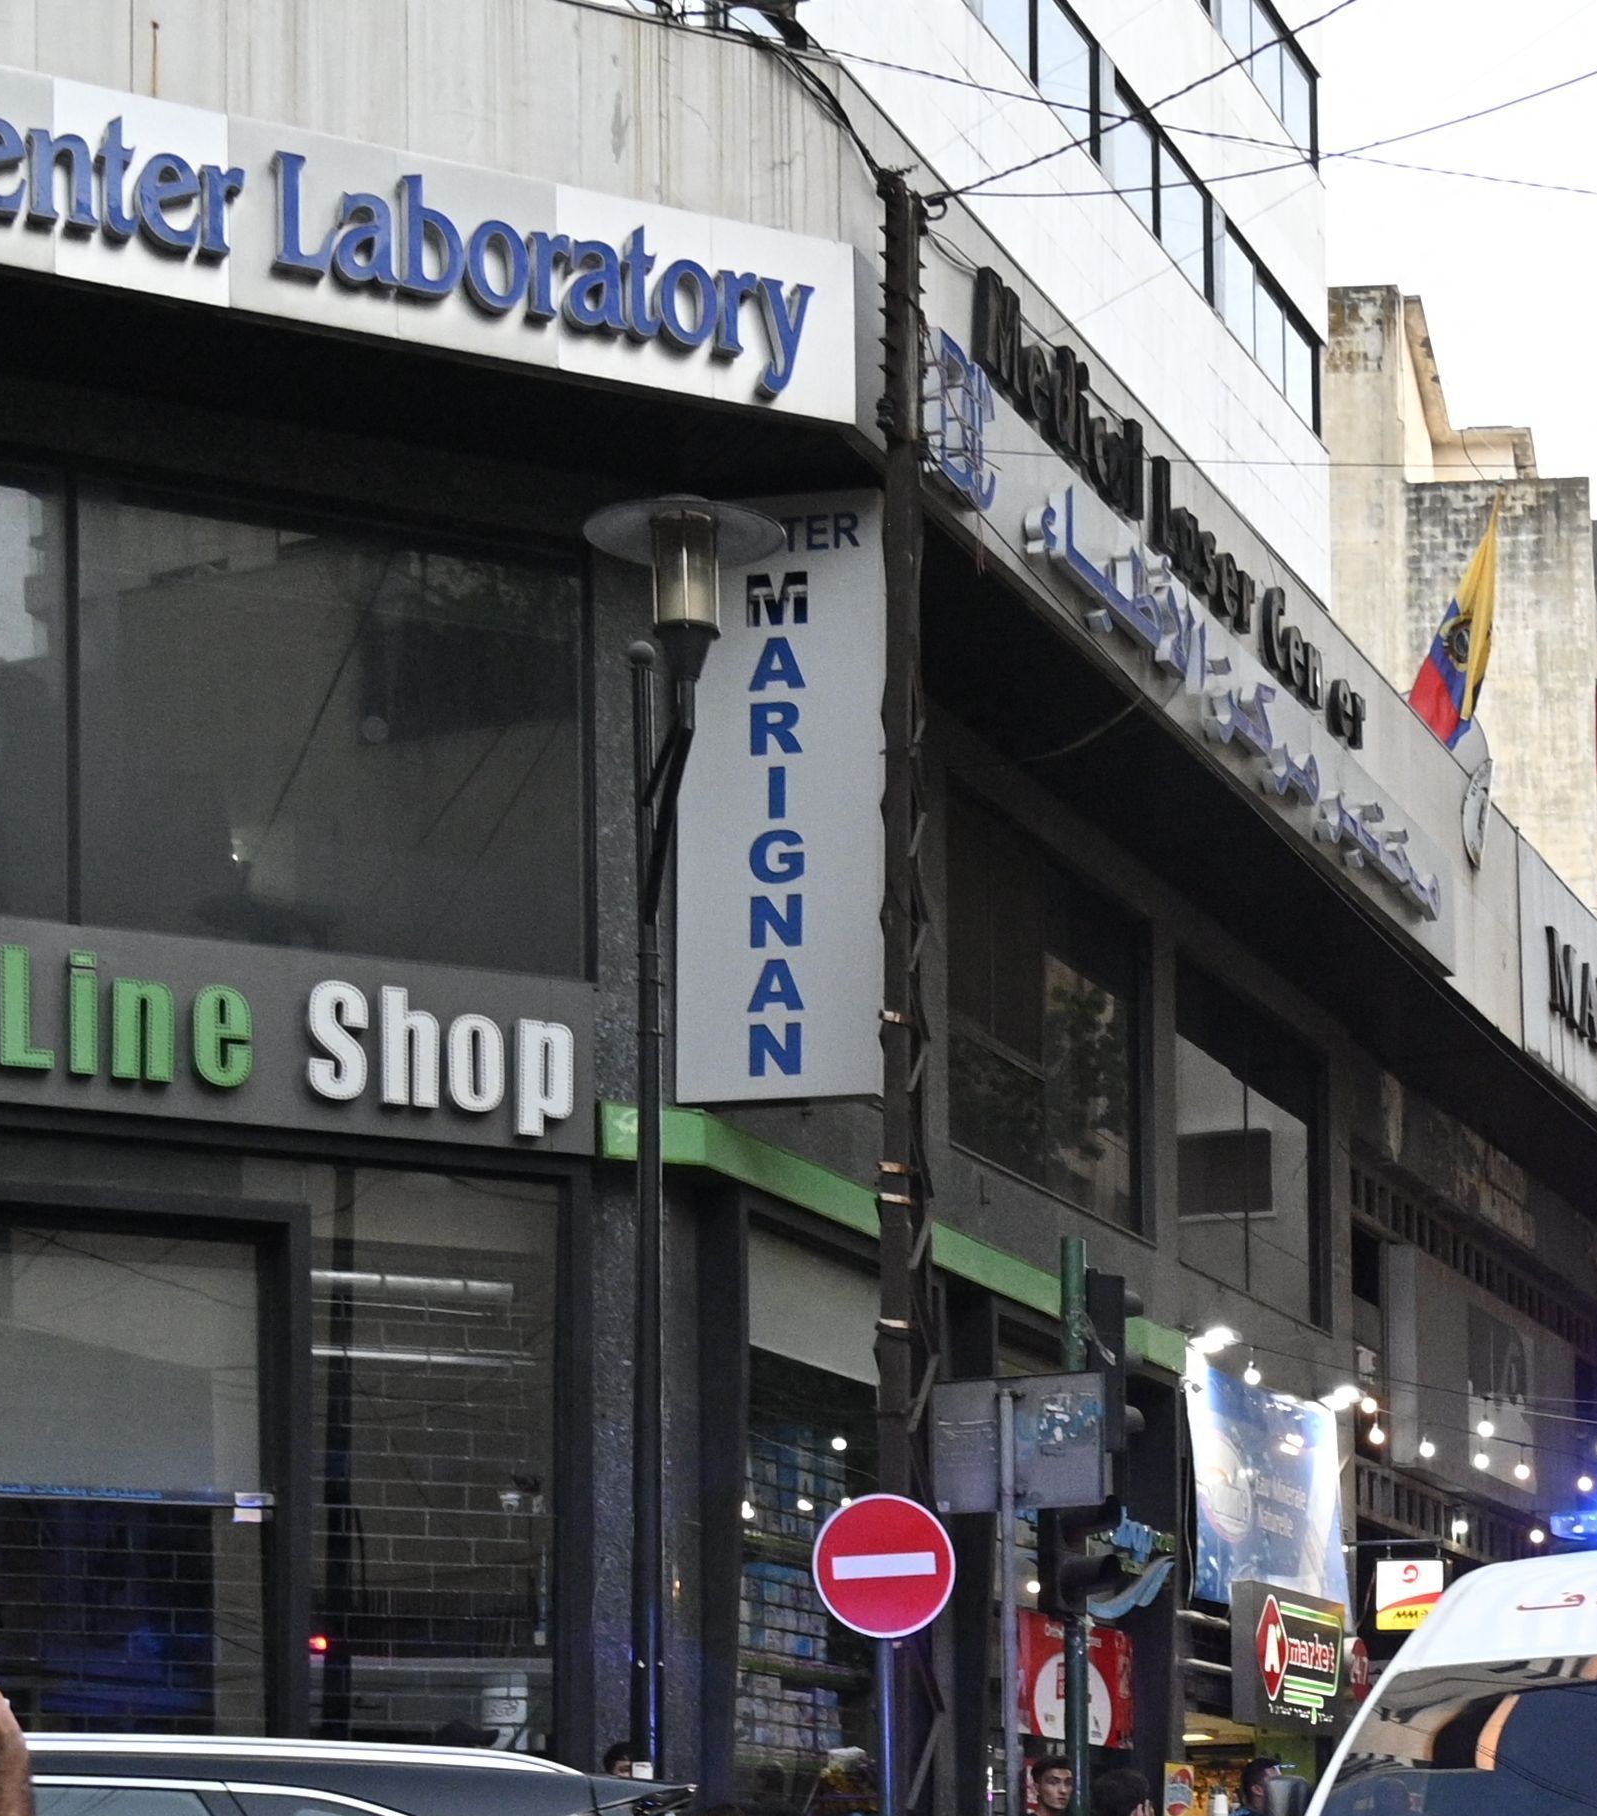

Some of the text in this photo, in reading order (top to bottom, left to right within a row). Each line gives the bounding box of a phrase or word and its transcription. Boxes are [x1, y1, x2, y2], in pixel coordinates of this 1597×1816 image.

[270, 150, 815, 402] Laboratory
[1151, 453, 1257, 634] Laser
[745, 570, 809, 1079] MARIGNAN
[306, 977, 575, 1137] Shop
